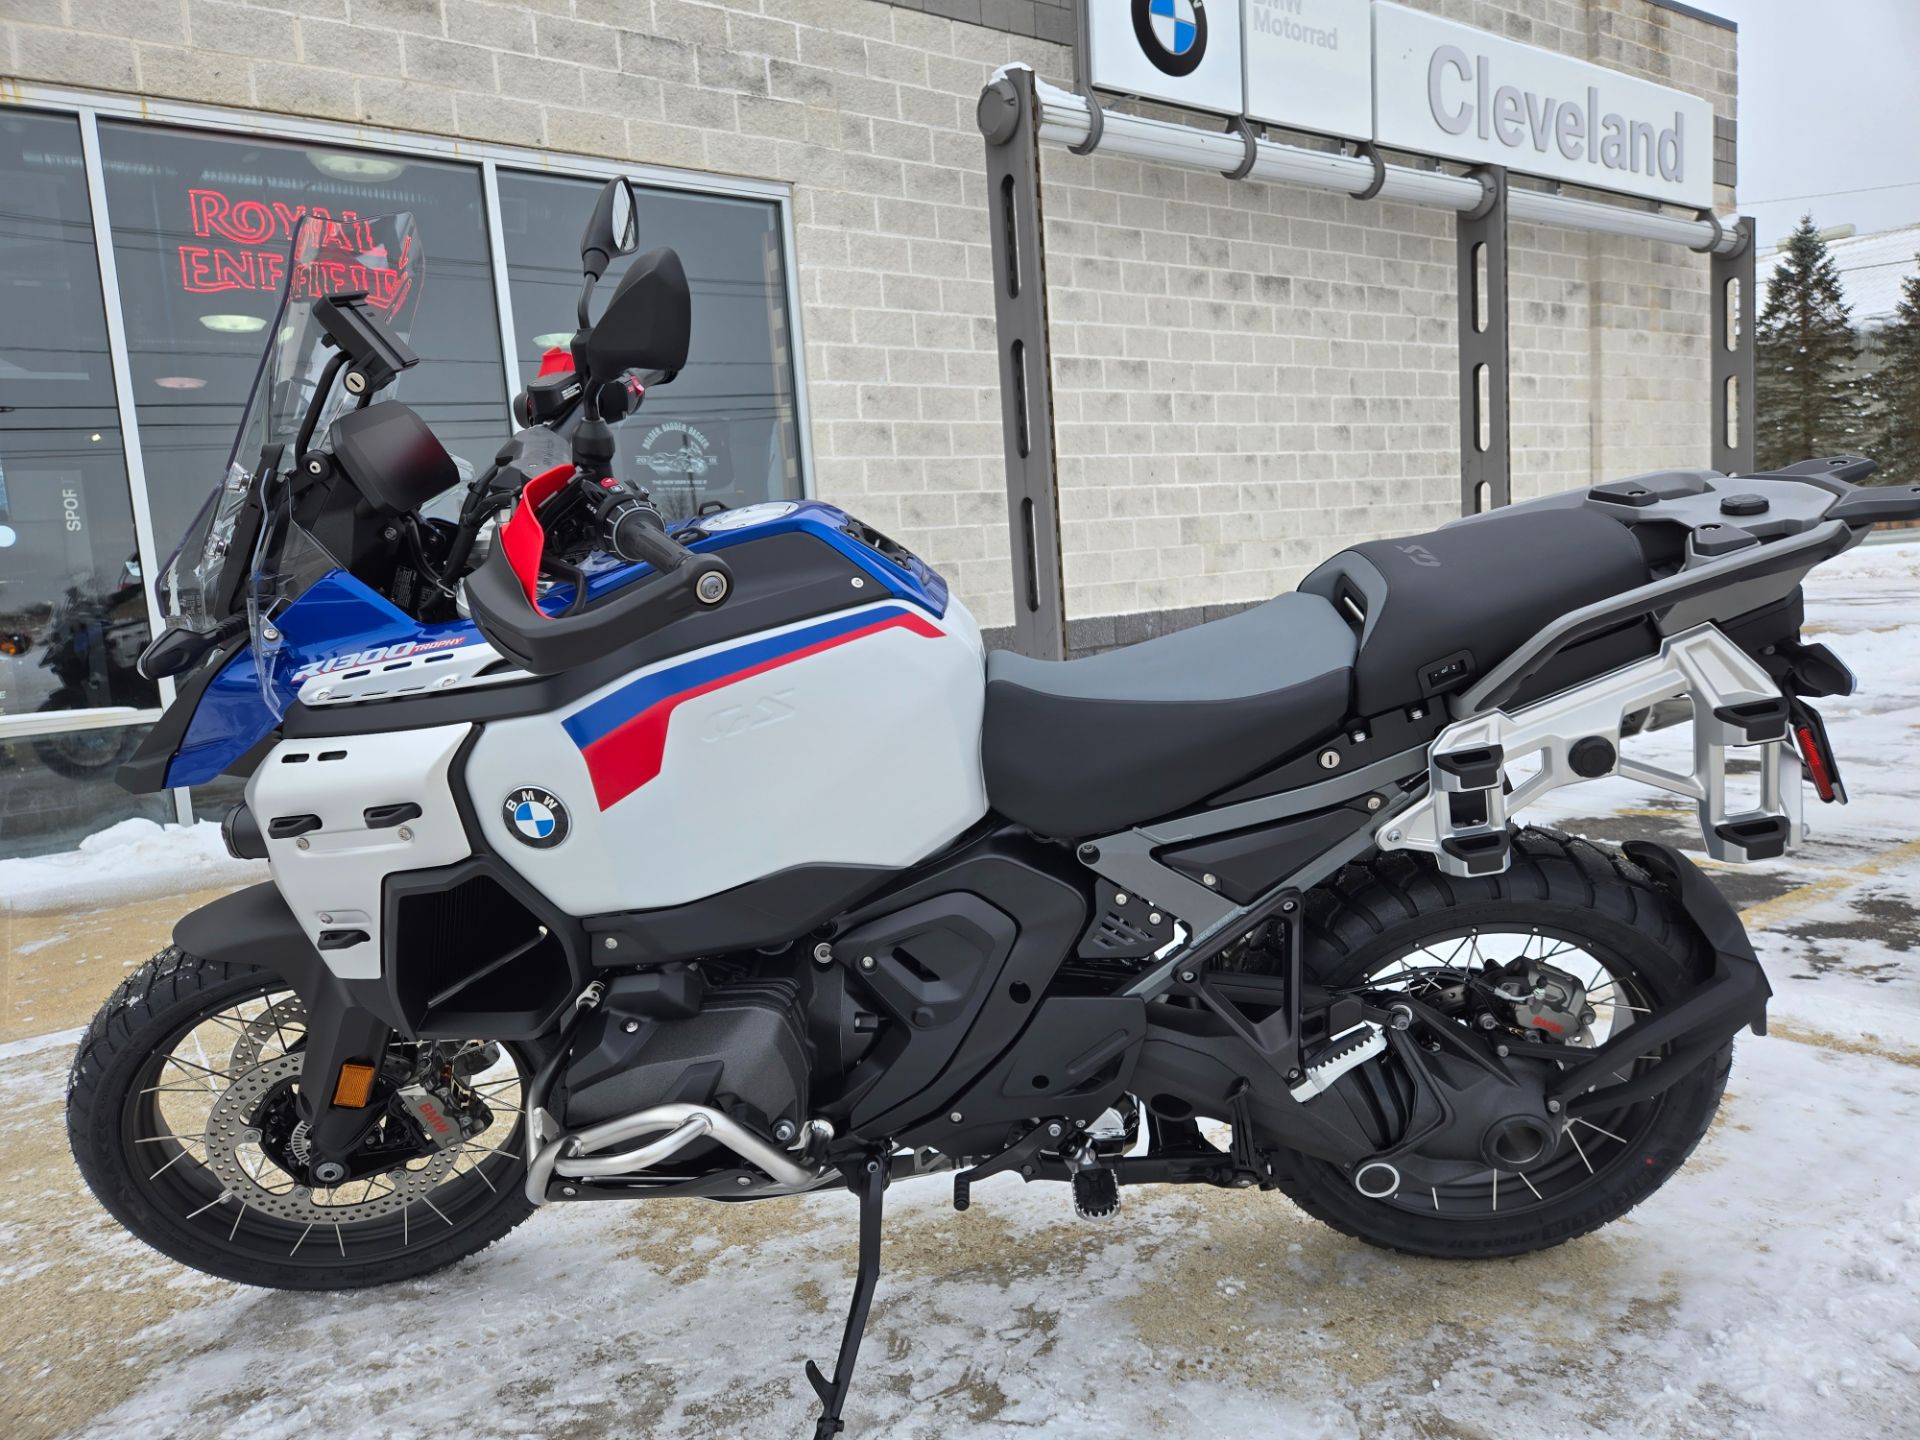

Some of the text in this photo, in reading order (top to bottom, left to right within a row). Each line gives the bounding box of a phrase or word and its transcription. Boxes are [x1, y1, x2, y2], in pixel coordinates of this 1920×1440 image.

[1253, 5, 1338, 50] Motorrad
[1428, 44, 1684, 183] Cleveland
[188, 189, 388, 258] ROYAL
[290, 637, 468, 685] R1300 TROPHY
[505, 790, 559, 813] BMW
[417, 1103, 450, 1133] BMW
